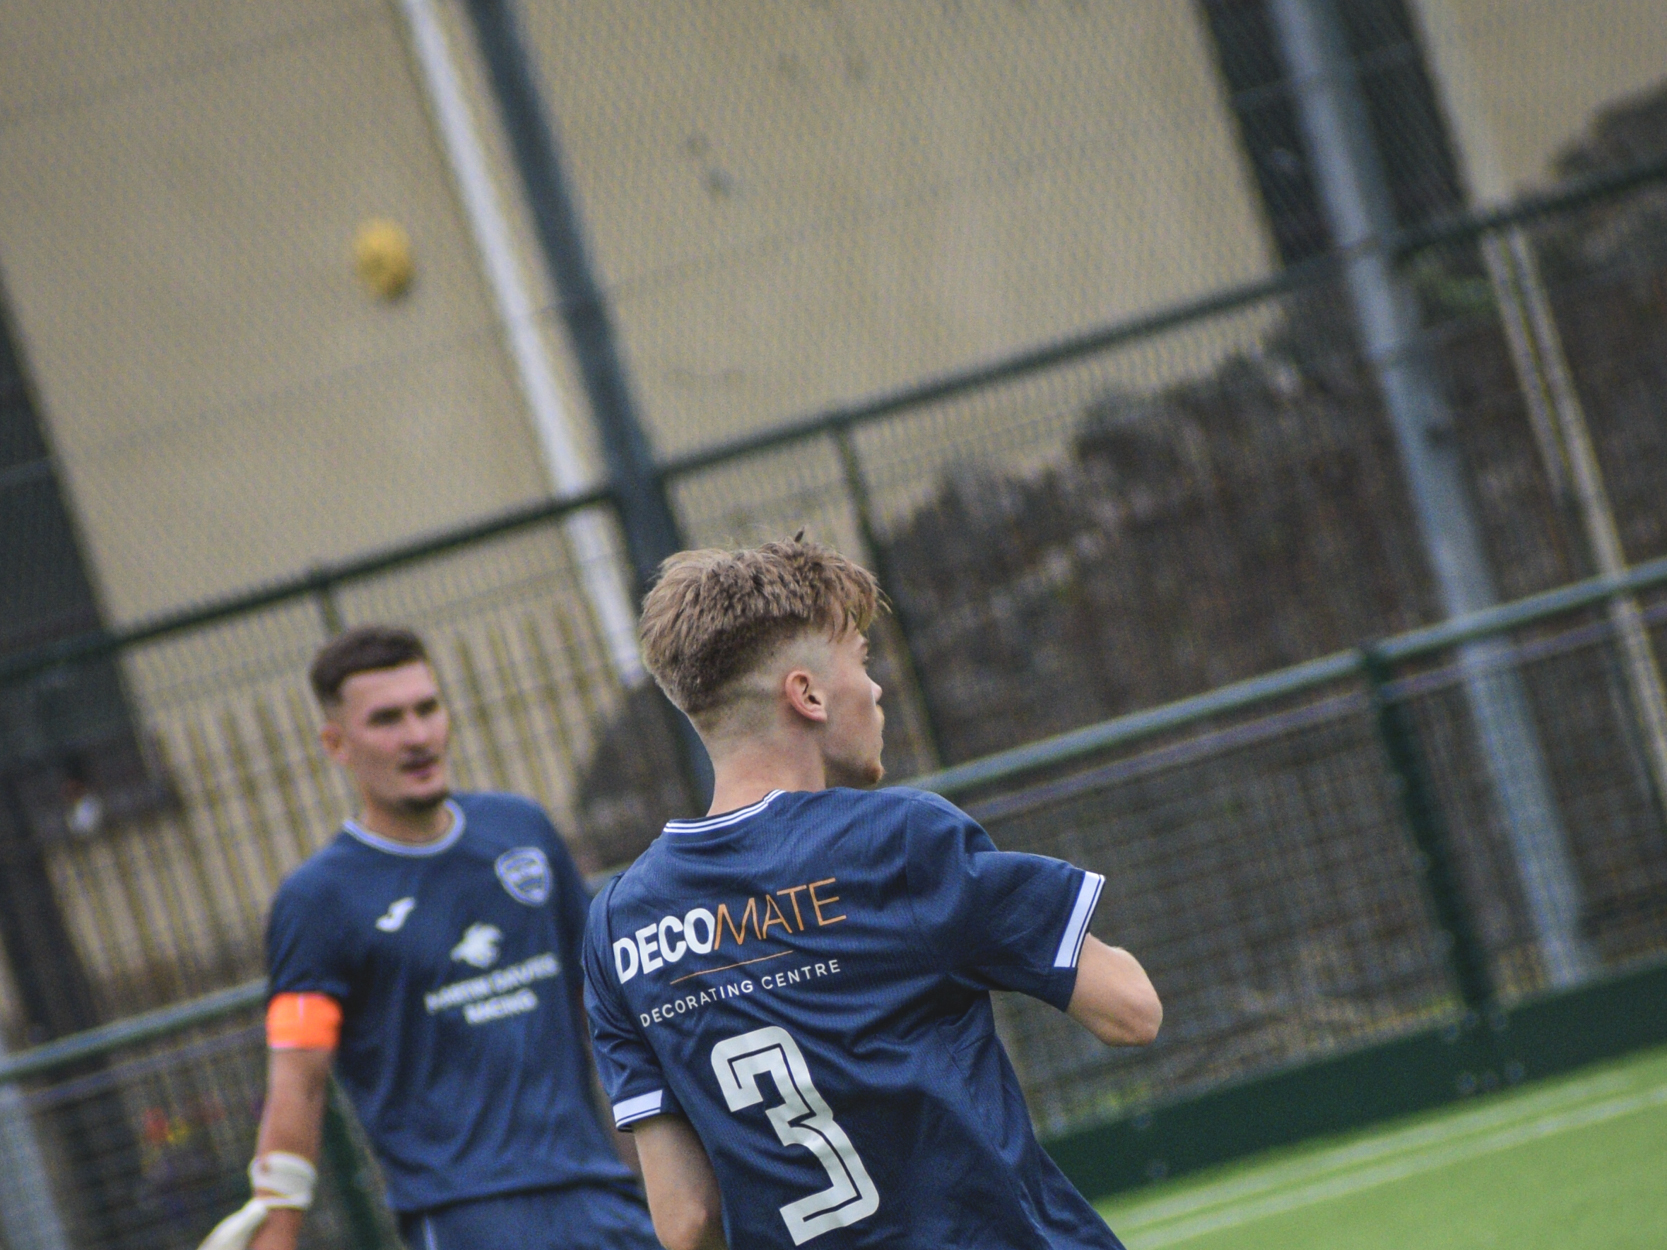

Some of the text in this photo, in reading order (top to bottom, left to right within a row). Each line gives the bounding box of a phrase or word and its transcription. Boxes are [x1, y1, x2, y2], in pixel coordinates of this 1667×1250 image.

[612, 877, 847, 985] DECOMATE
[640, 959, 841, 1028] DECORATING CENTRE
[710, 1026, 880, 1247] 3
